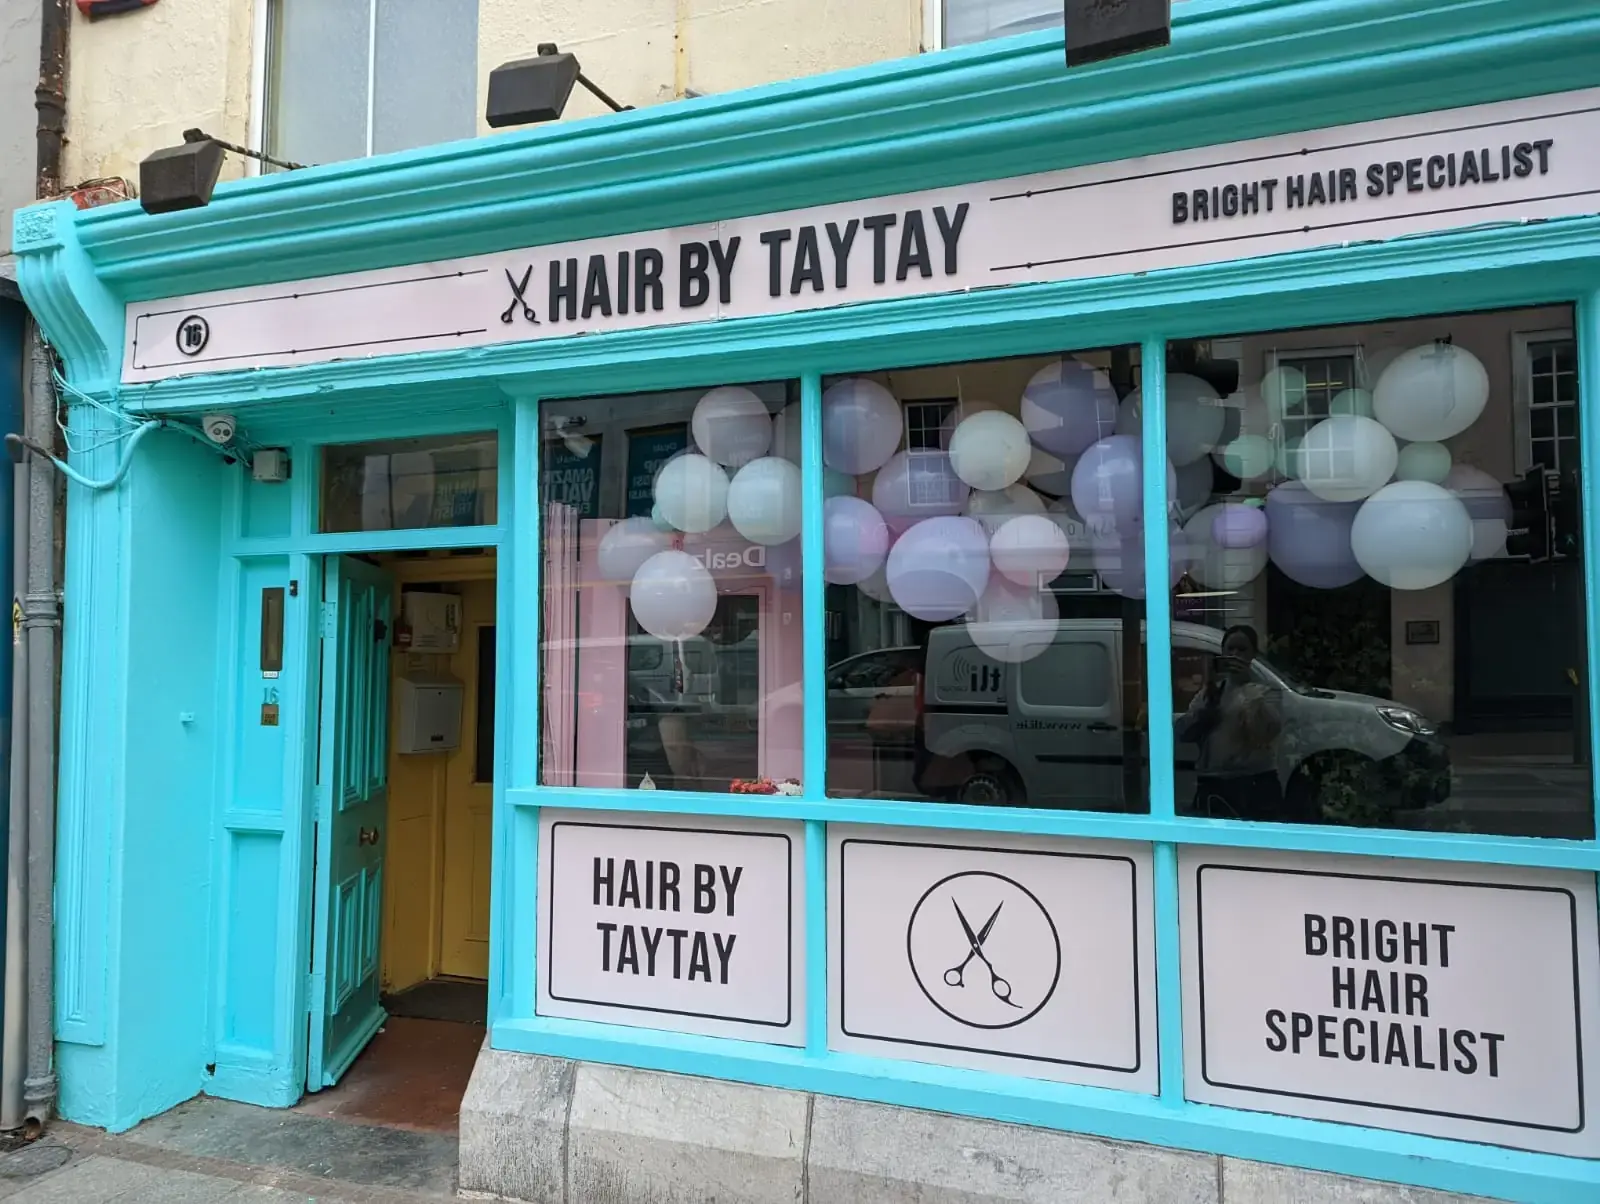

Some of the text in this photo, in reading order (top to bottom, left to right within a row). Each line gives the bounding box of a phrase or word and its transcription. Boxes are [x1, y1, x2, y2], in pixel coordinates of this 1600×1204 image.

[1172, 139, 1554, 225] BRIGHT HAIR SPECIALIST
[548, 202, 970, 323] HAIR BY TAYTAY
[183, 322, 203, 347] 16
[593, 857, 743, 917] HAIR BY
[596, 922, 737, 985] TAYTAY
[1304, 913, 1456, 968] BRIGHT
[1332, 965, 1429, 1018] HAIR
[1265, 1009, 1505, 1078] SPECIALIST
